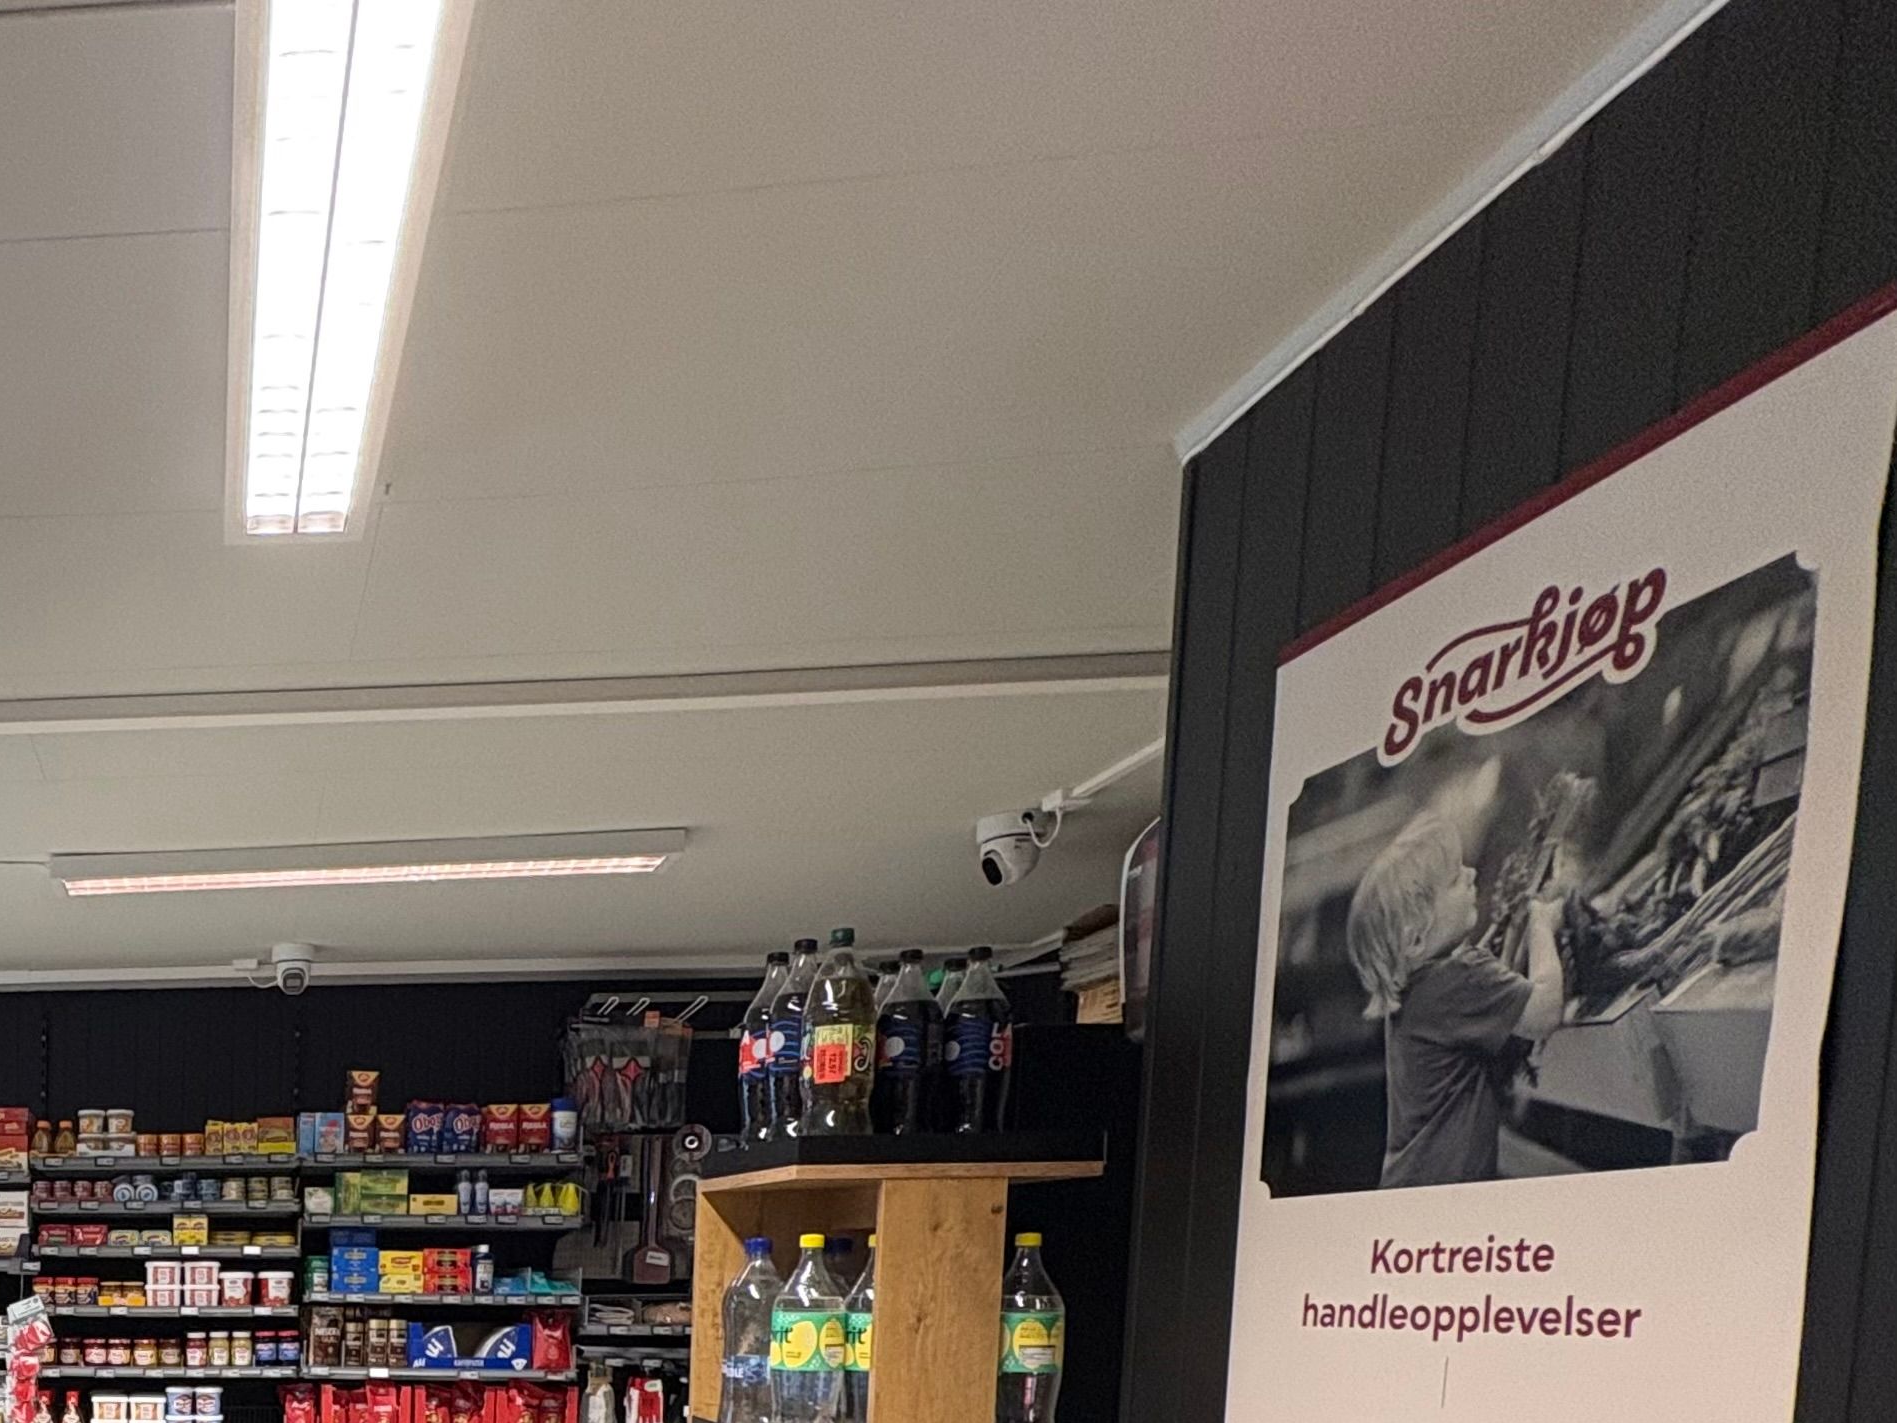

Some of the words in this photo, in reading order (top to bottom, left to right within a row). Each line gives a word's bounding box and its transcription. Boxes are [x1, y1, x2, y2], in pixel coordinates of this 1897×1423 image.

[1383, 567, 1669, 758] Snarkjøp
[1369, 1234, 1556, 1276] Kortreiste
[1301, 1293, 1643, 1342] handleopplevelser
